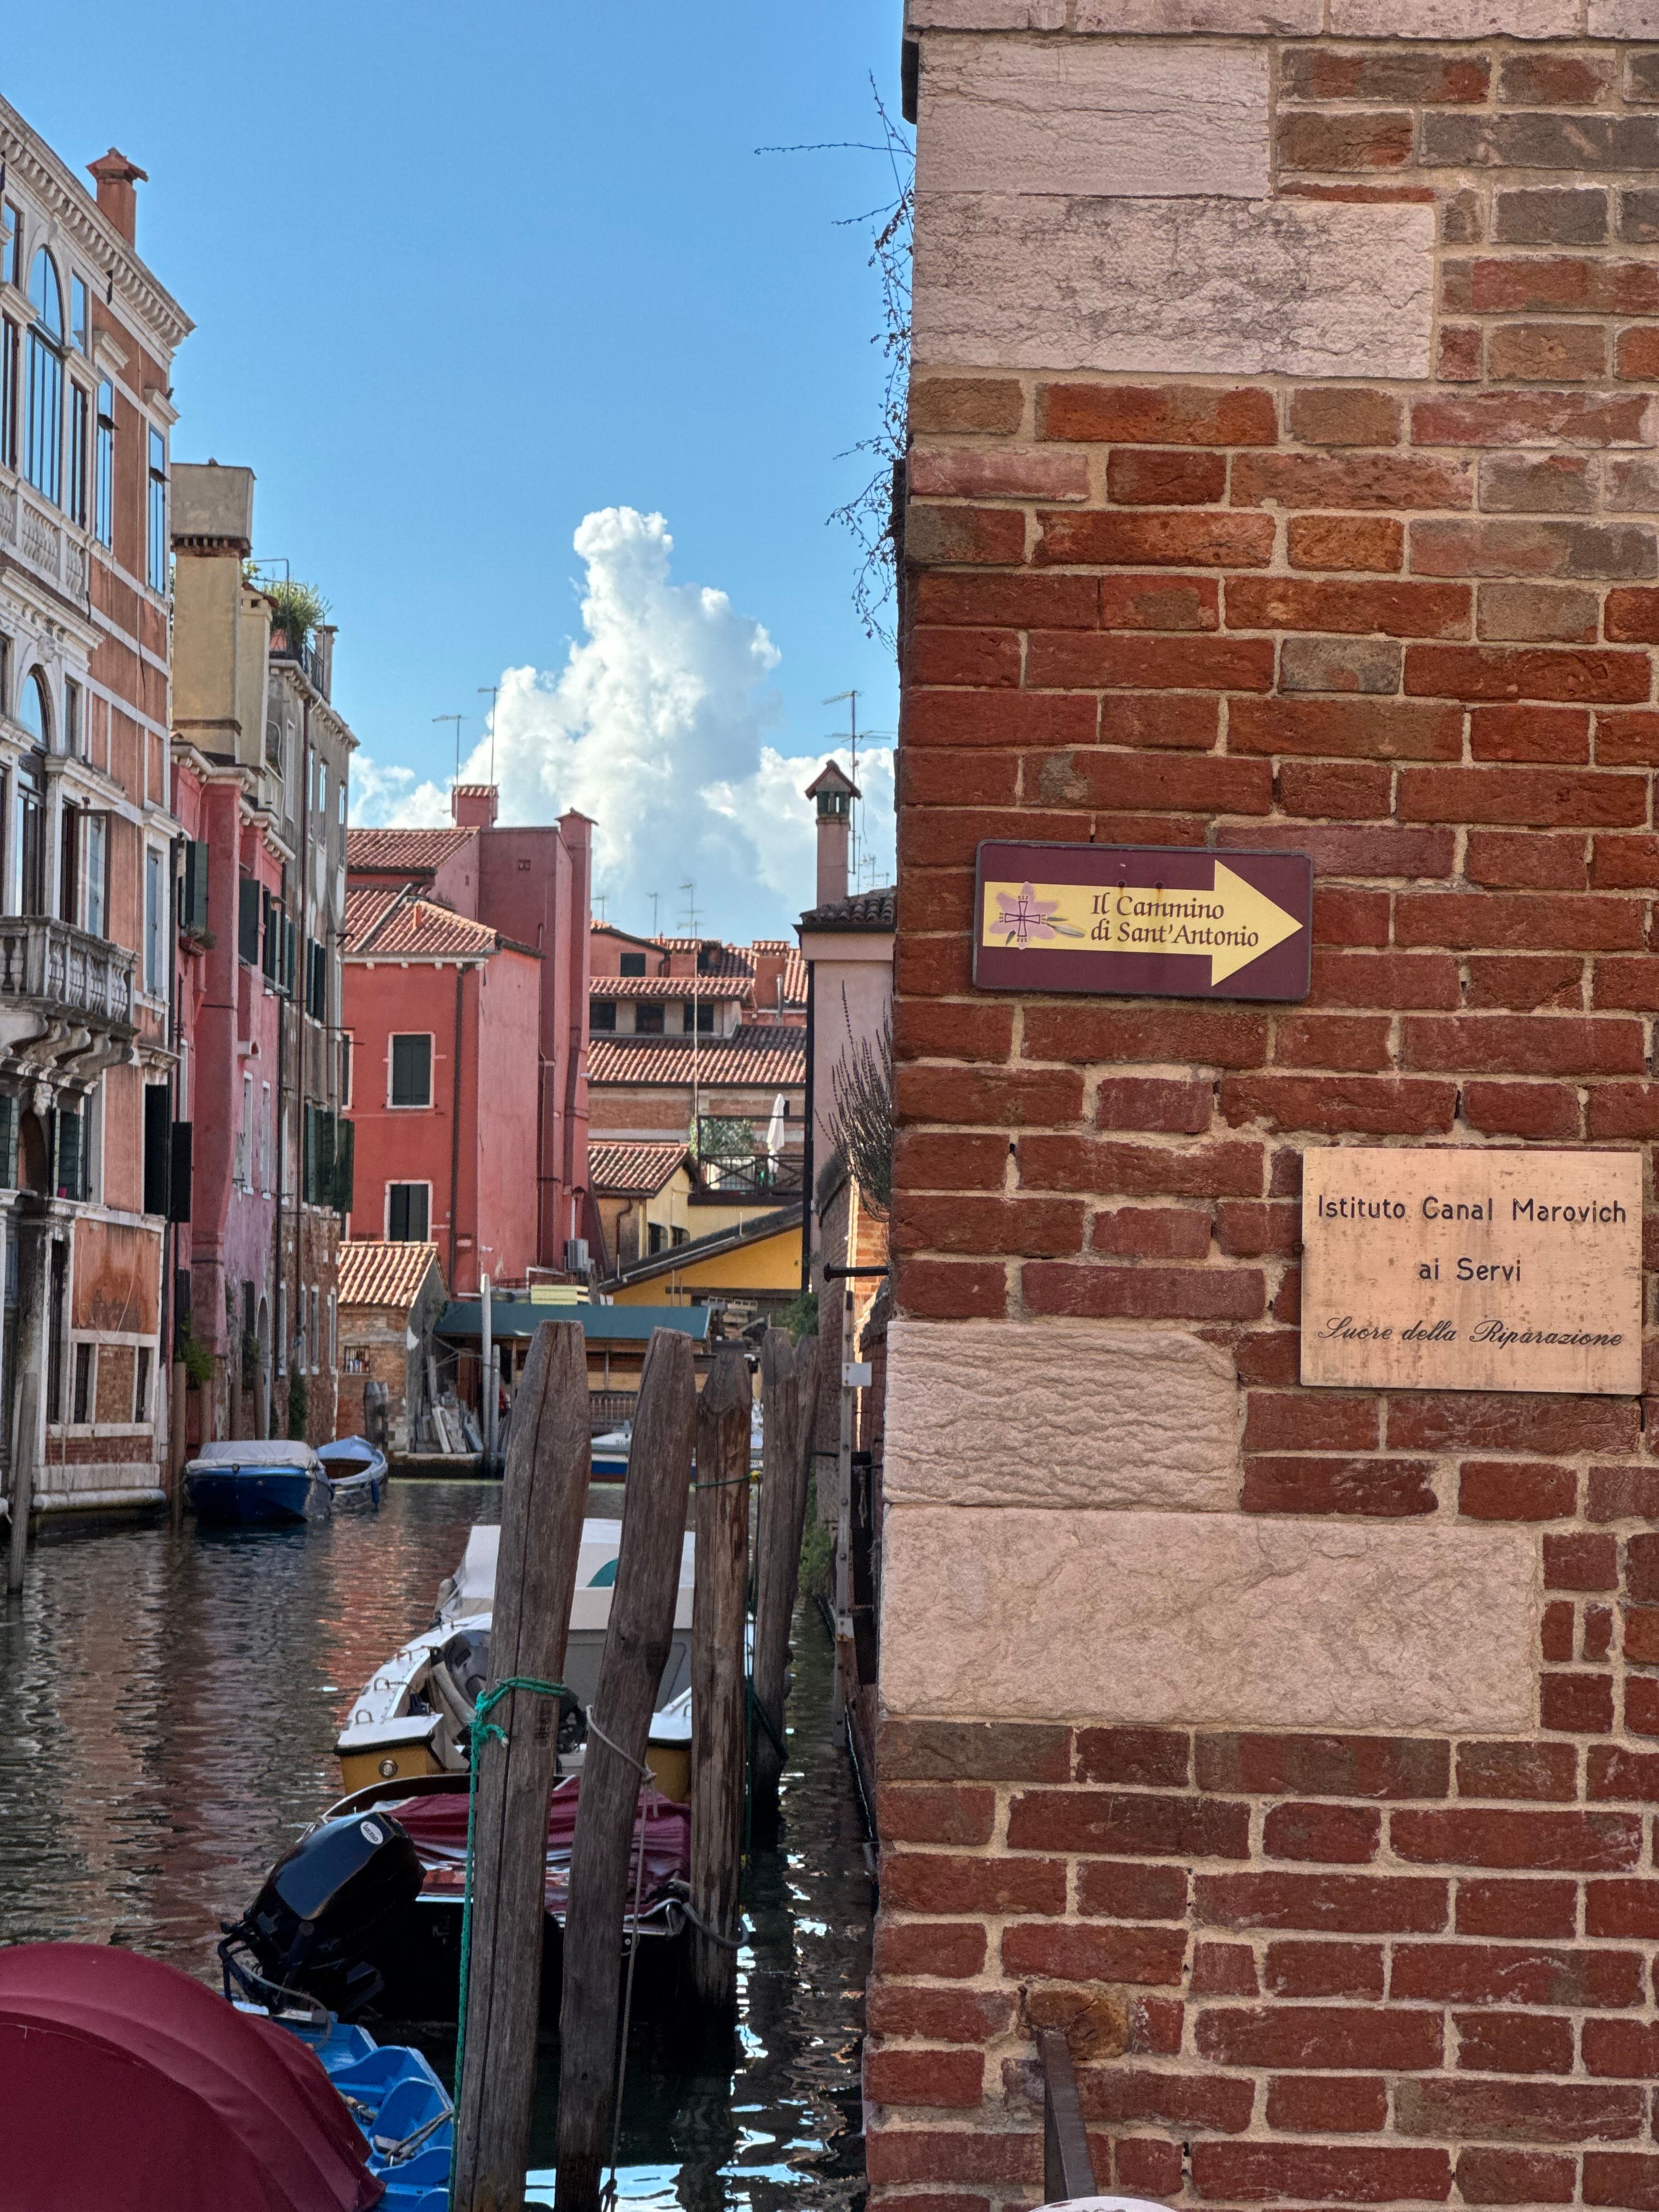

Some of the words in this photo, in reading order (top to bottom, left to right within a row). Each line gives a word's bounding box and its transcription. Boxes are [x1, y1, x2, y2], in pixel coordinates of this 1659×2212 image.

[1091, 892, 1110, 915] Il
[1117, 895, 1224, 919] Cammino
[1091, 918, 1111, 941] di
[1118, 922, 1259, 947] Sant'Antonio
[1319, 1195, 1406, 1219] Istituto
[1423, 1197, 1492, 1221] Canal
[1513, 1198, 1626, 1223] Marovich
[1419, 1258, 1438, 1280] ai
[1457, 1257, 1520, 1282] Servi
[1318, 1316, 1392, 1339] Suore
[1402, 1320, 1457, 1341] della
[1469, 1319, 1622, 1349] Riparazione
